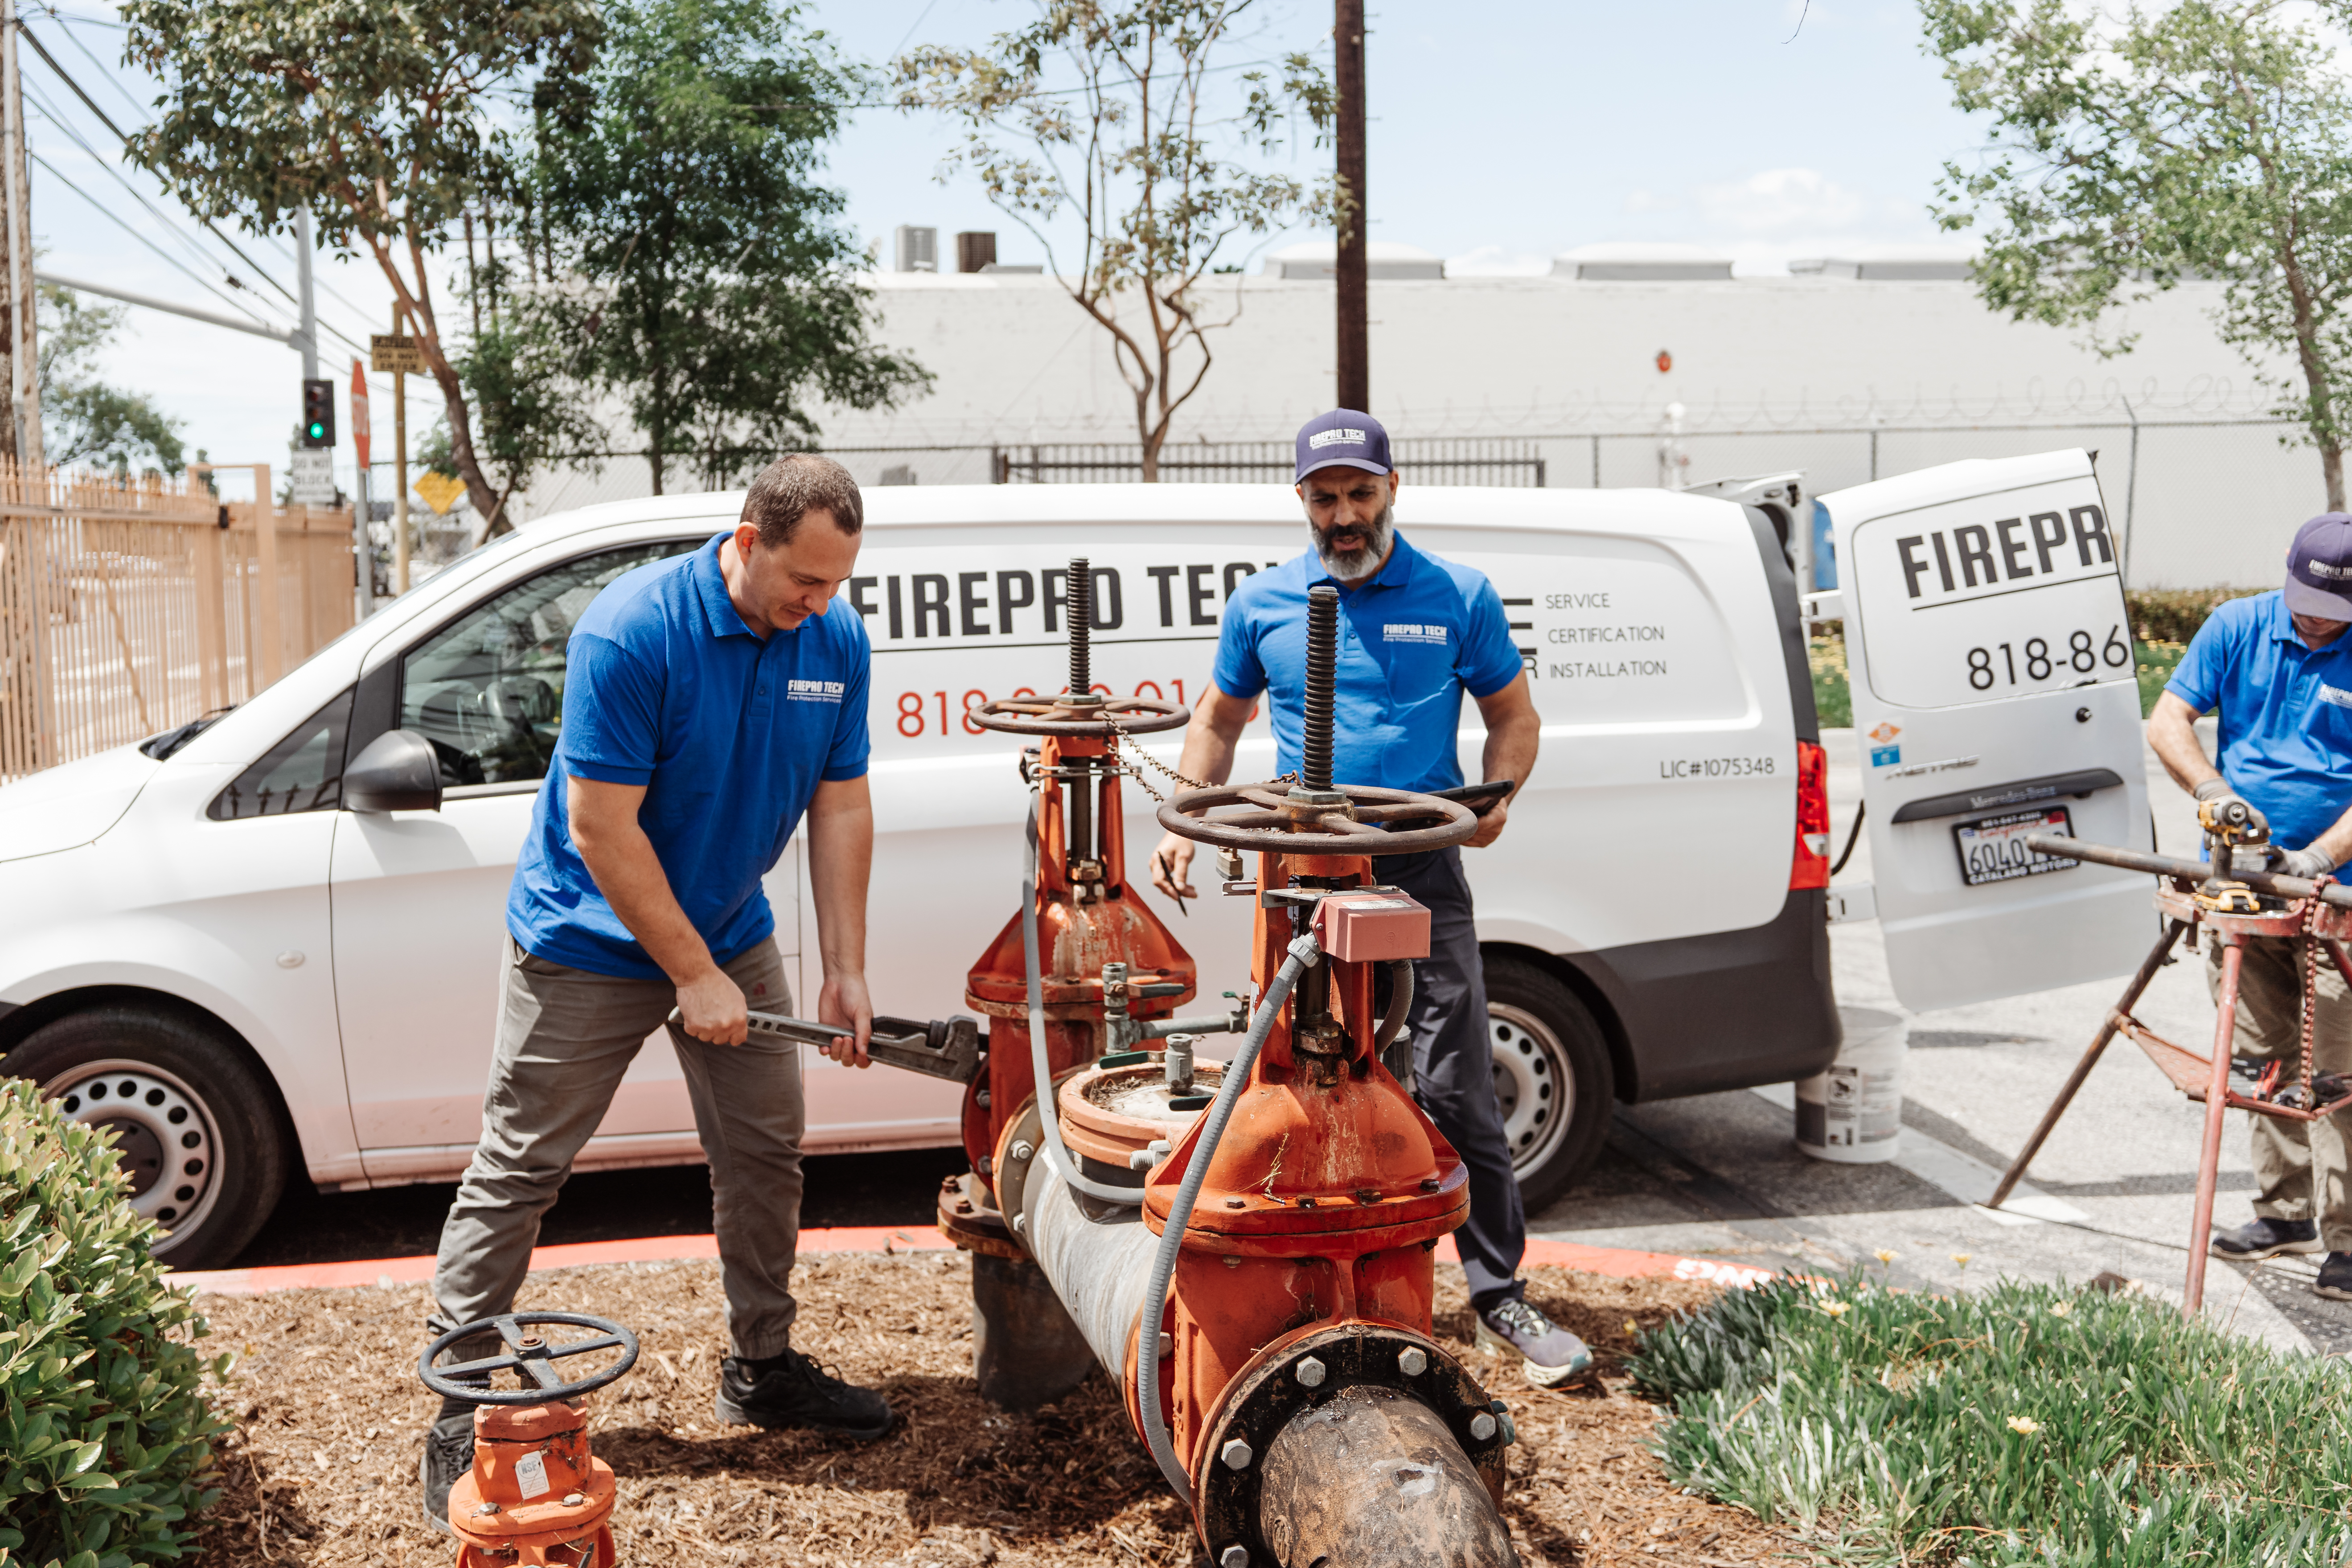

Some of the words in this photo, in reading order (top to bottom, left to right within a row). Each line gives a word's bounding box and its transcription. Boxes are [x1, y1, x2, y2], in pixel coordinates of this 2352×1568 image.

[1309, 429, 1342, 444] FIREPRO
[1343, 428, 1365, 439] TECH
[1896, 504, 2112, 598] FIREPR
[2343, 567, 2352, 576] TE
[850, 567, 1123, 639] FIREPRO
[1147, 562, 1278, 628] TE
[1546, 593, 1610, 609] SERVICE
[1383, 624, 1423, 635] FIREPRO
[1424, 625, 1447, 637] TECH
[1548, 626, 1664, 644] CERTIFICATION
[1967, 624, 2128, 690] 818-86
[1550, 660, 1667, 679] INSTALLATION
[788, 680, 822, 692] FIREPRO
[824, 681, 844, 694] TECH
[2320, 684, 2352, 701] FIREPR
[1660, 758, 1774, 779] LIC#1075348
[1970, 831, 2065, 874] 6040
